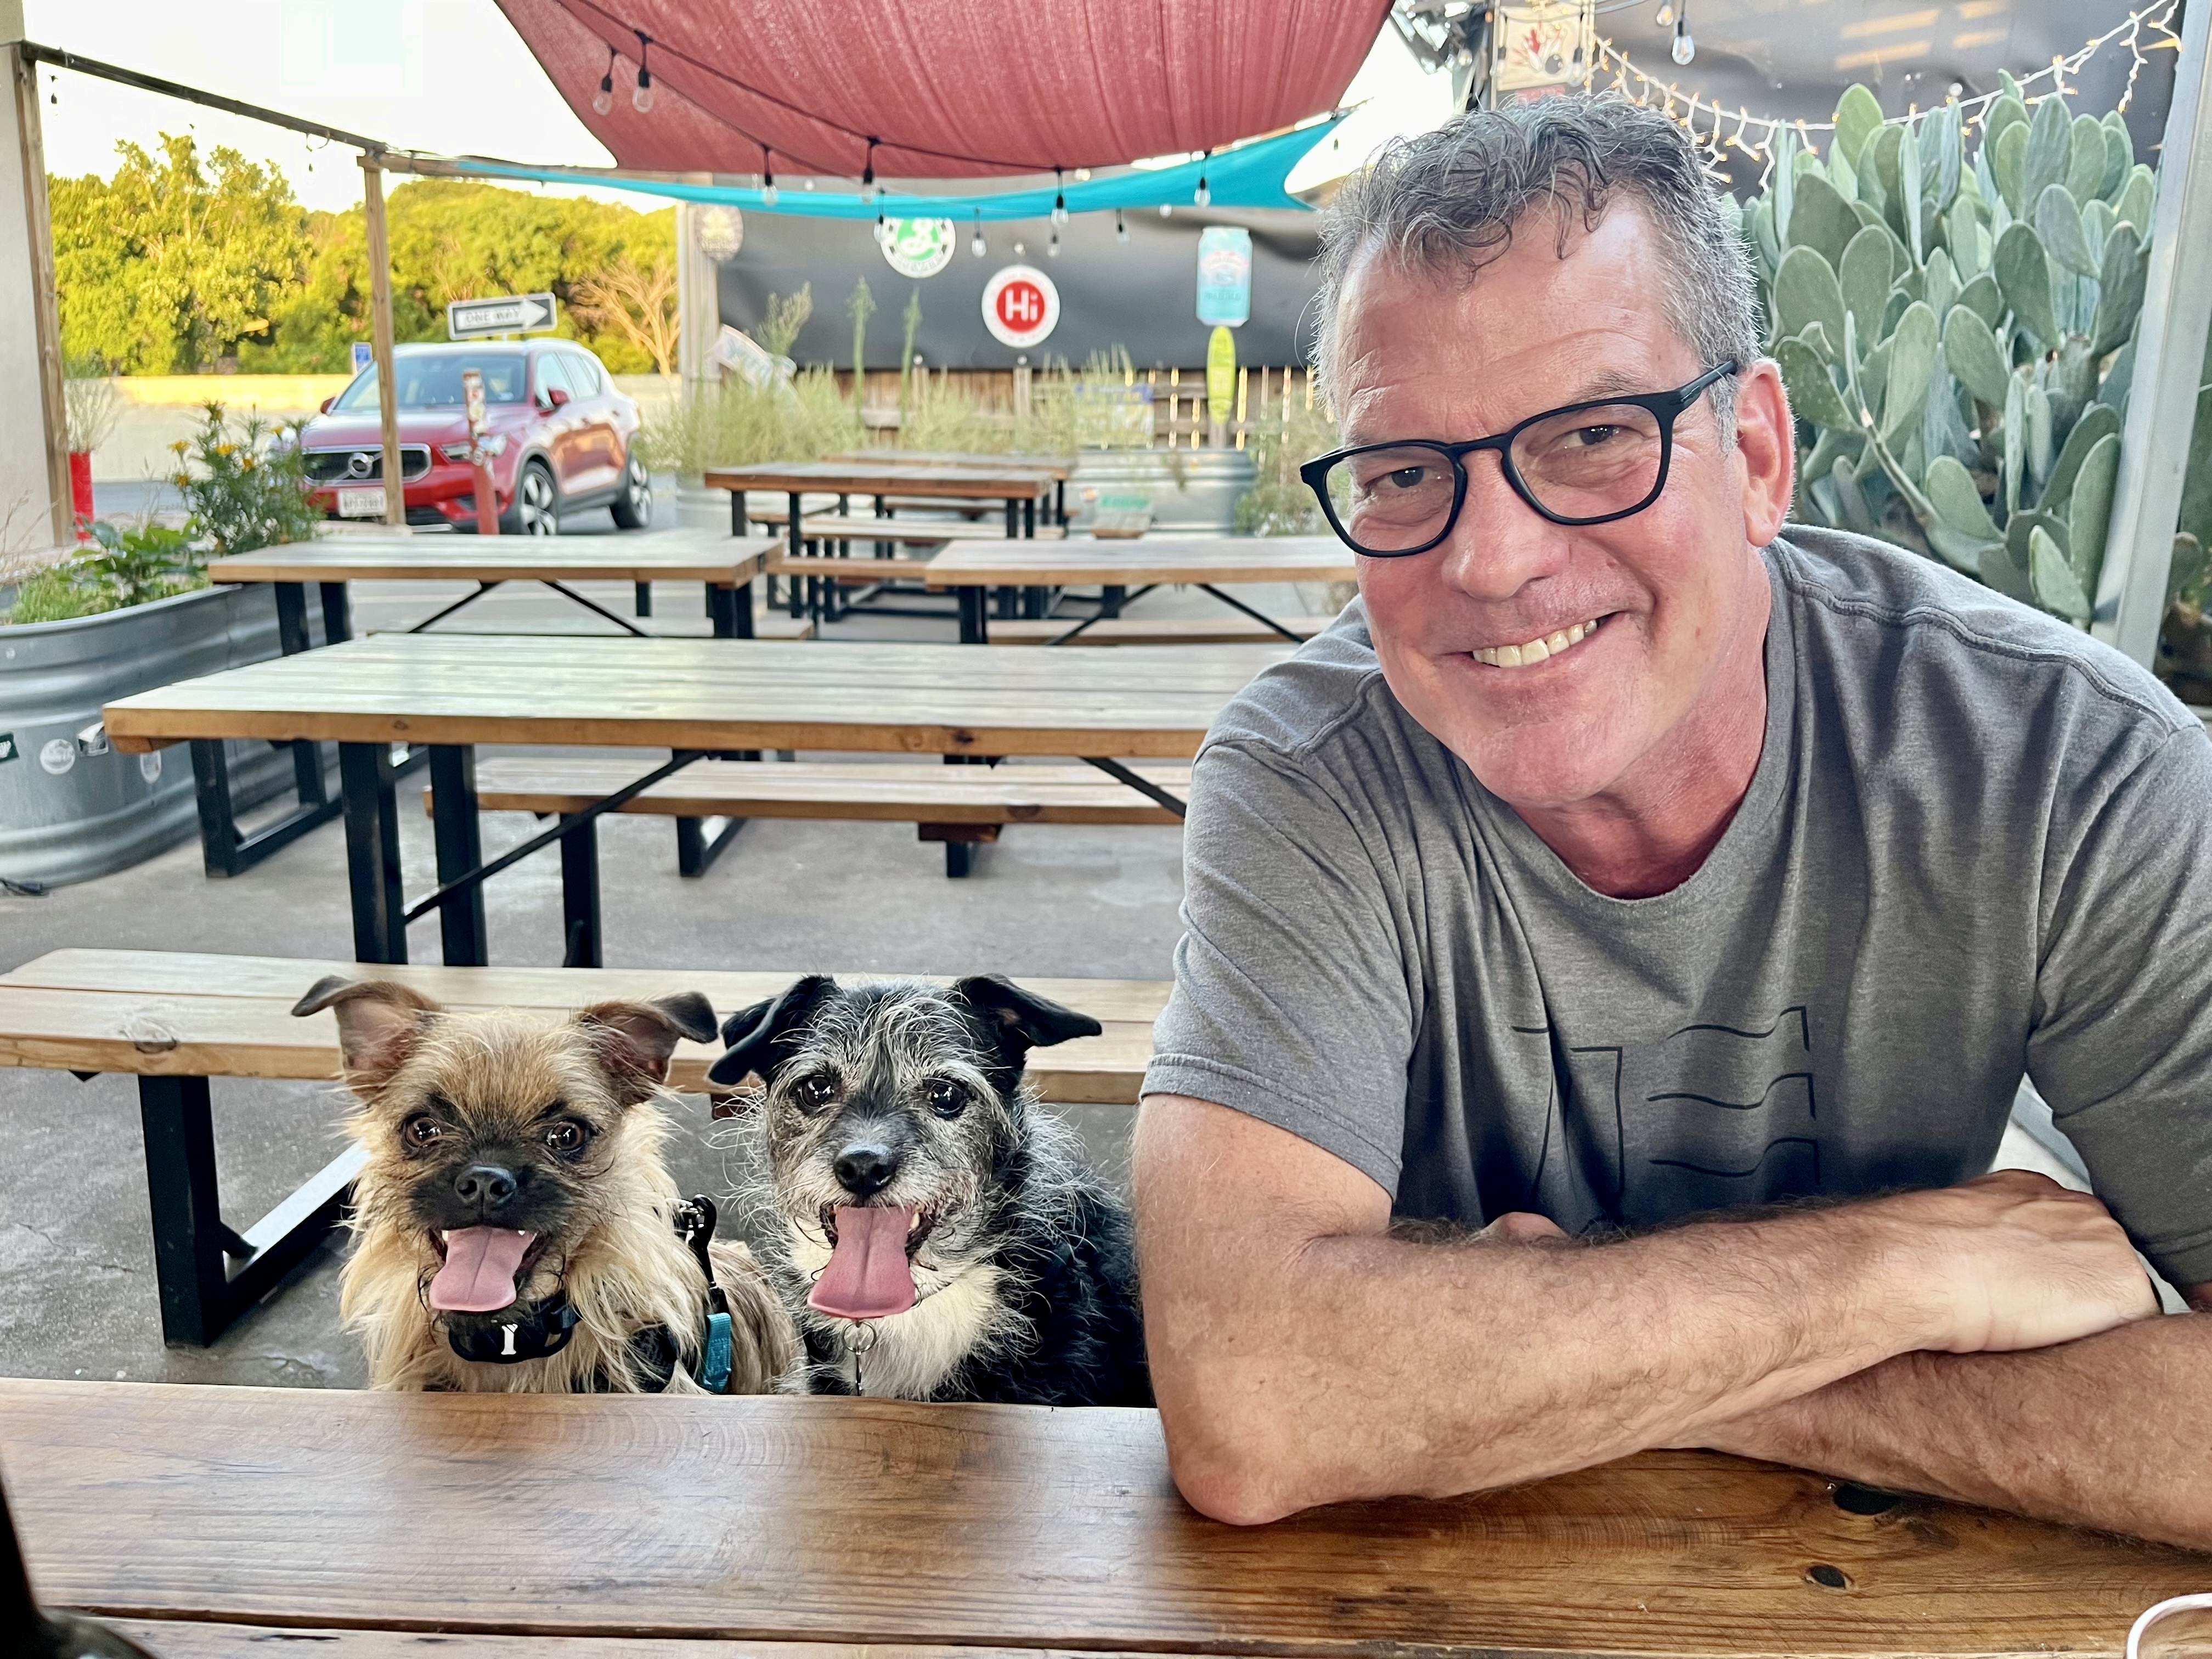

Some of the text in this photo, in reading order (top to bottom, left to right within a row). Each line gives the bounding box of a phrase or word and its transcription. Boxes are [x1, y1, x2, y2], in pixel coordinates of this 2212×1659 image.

[466, 307, 520, 323] ONE WAY
[1006, 289, 1038, 321] Hi
